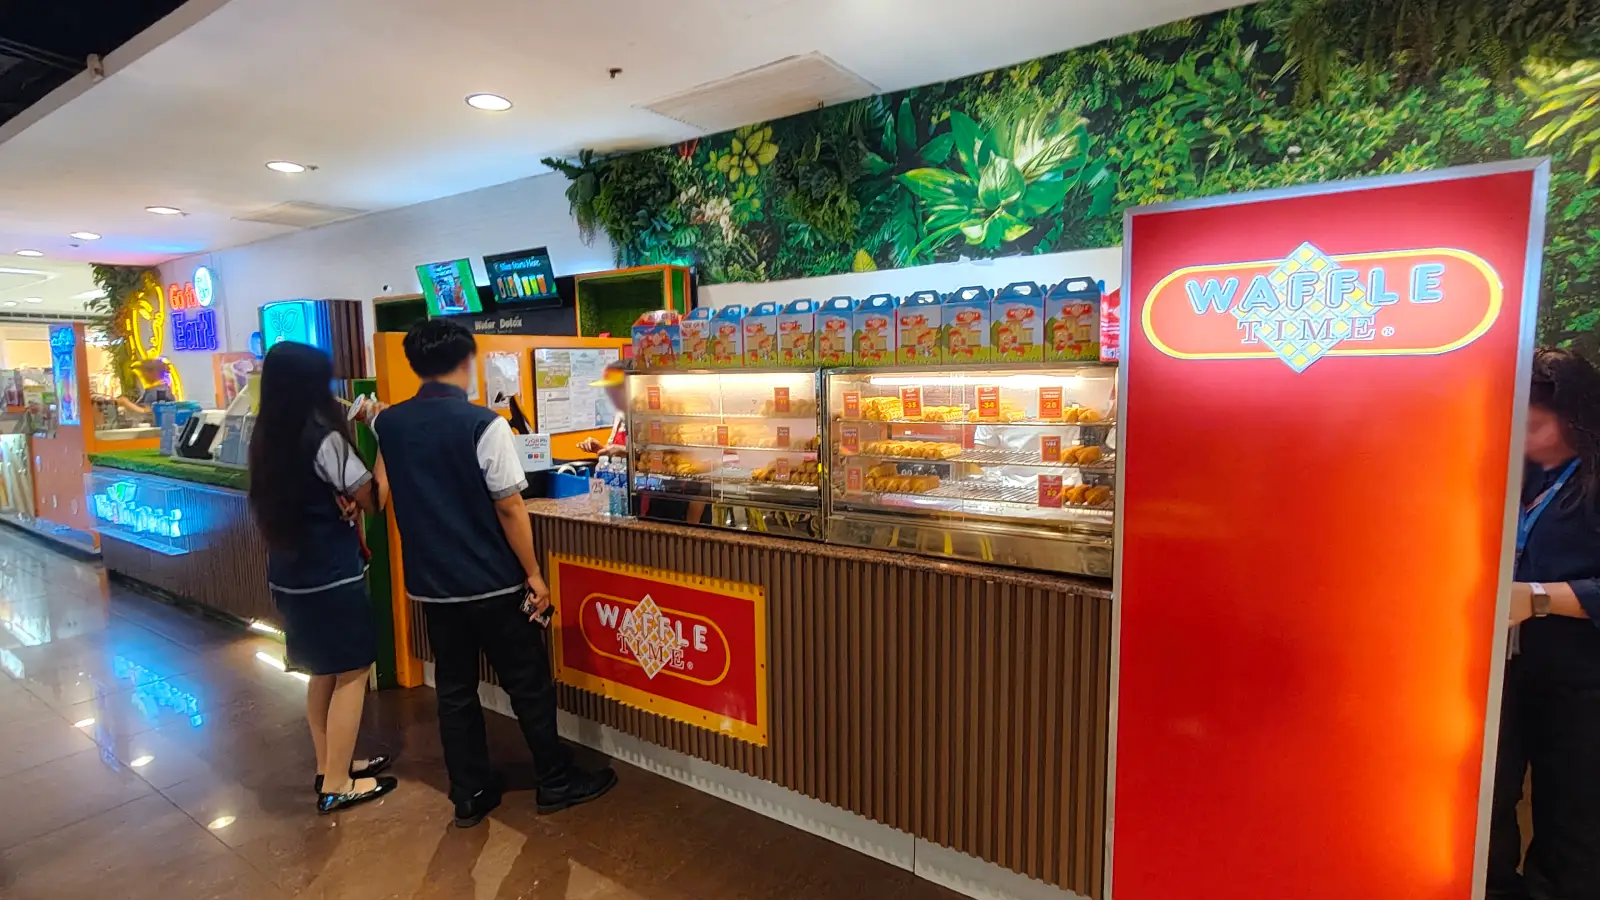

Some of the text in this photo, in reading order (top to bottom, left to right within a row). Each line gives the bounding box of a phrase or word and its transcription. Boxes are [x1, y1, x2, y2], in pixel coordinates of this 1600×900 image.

[1185, 262, 1445, 315] WAFFLE
[1237, 315, 1375, 344] TIME
[592, 482, 603, 493] 25
[595, 601, 708, 652] WAFFLE
[617, 632, 685, 670] TIME
